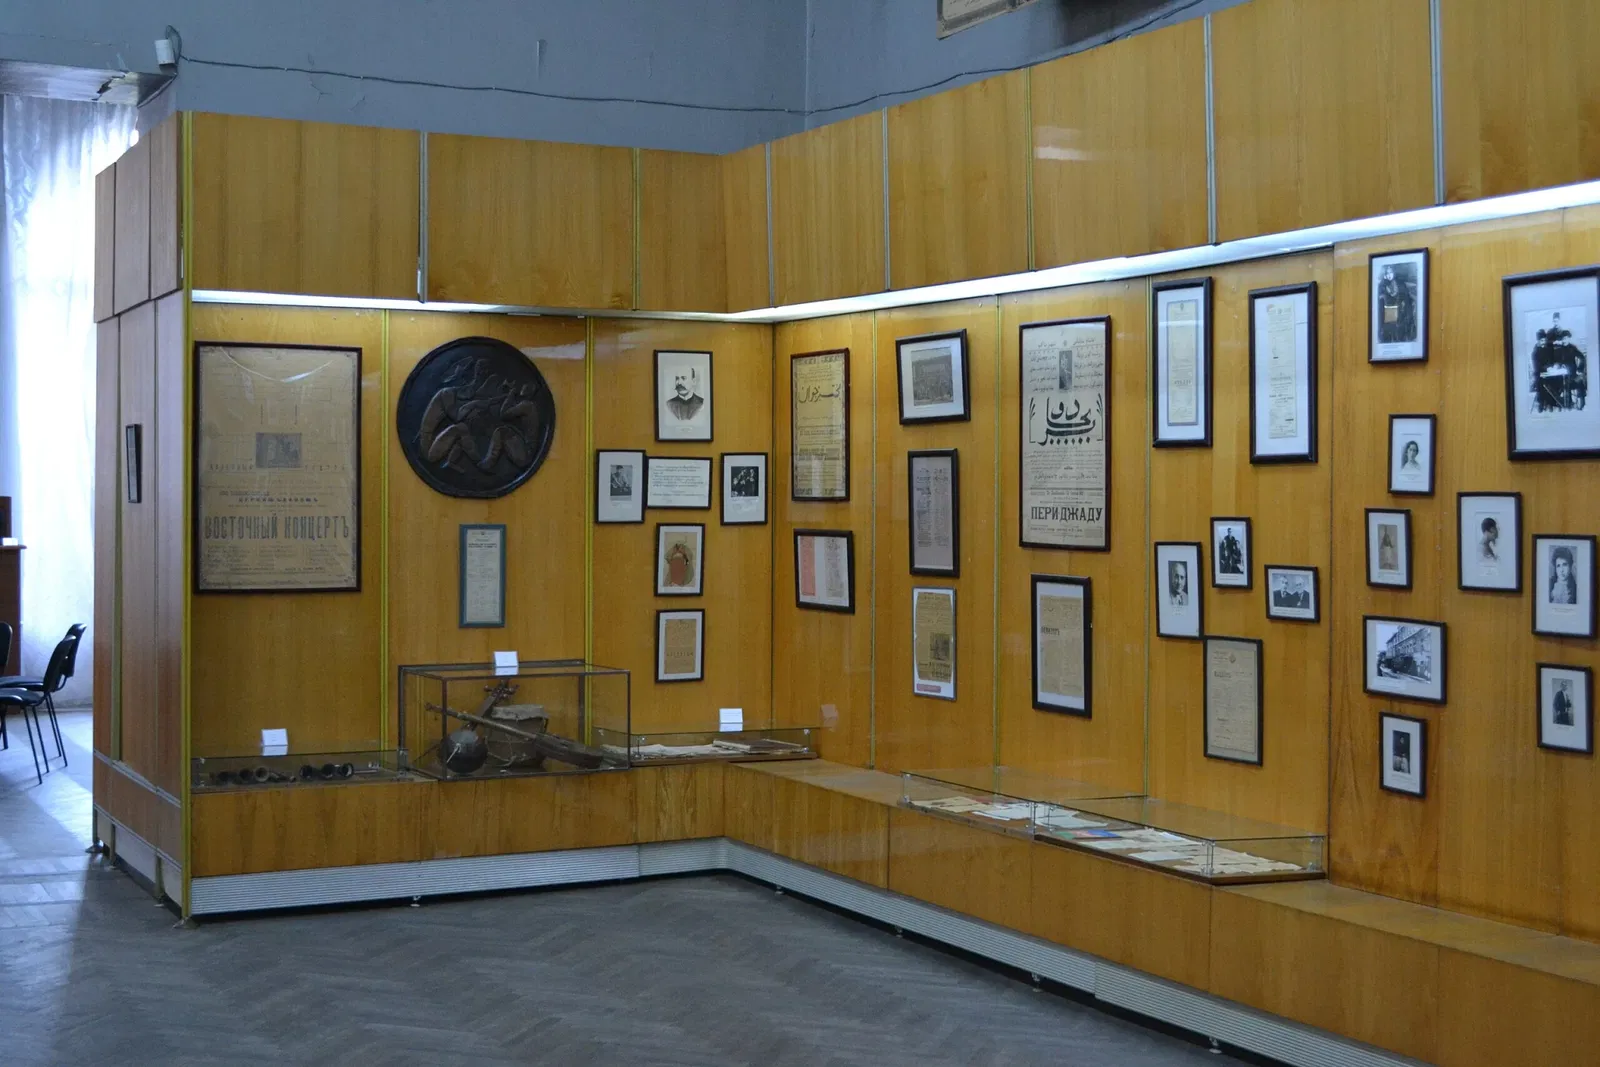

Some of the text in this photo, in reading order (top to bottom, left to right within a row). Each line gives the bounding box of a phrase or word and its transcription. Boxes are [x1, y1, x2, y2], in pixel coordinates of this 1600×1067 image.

[1031, 506, 1103, 523] ПЕРИДЖАДУ
[204, 513, 349, 541] ВОСТОЧНЫЙ КОНЦЕРТЪ
